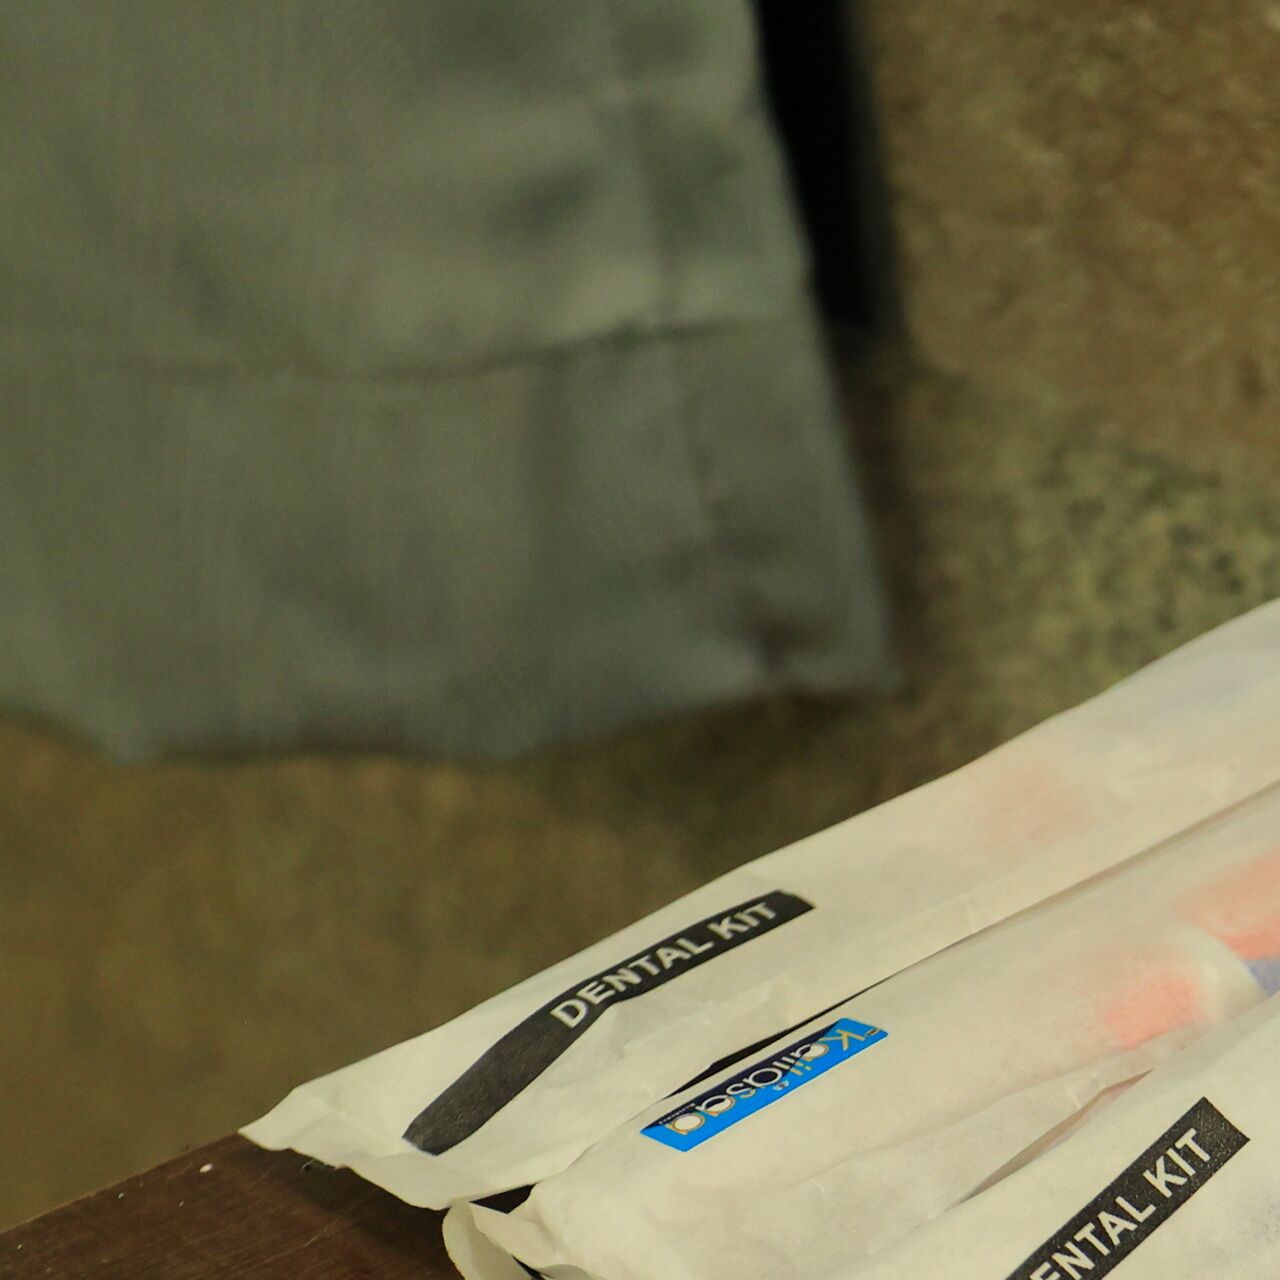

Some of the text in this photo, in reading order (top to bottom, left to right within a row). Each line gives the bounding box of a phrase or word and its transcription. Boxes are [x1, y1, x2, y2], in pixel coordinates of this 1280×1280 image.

[551, 902, 777, 1029] DENTAL KIT
[1148, 1127, 1214, 1200] KIT
